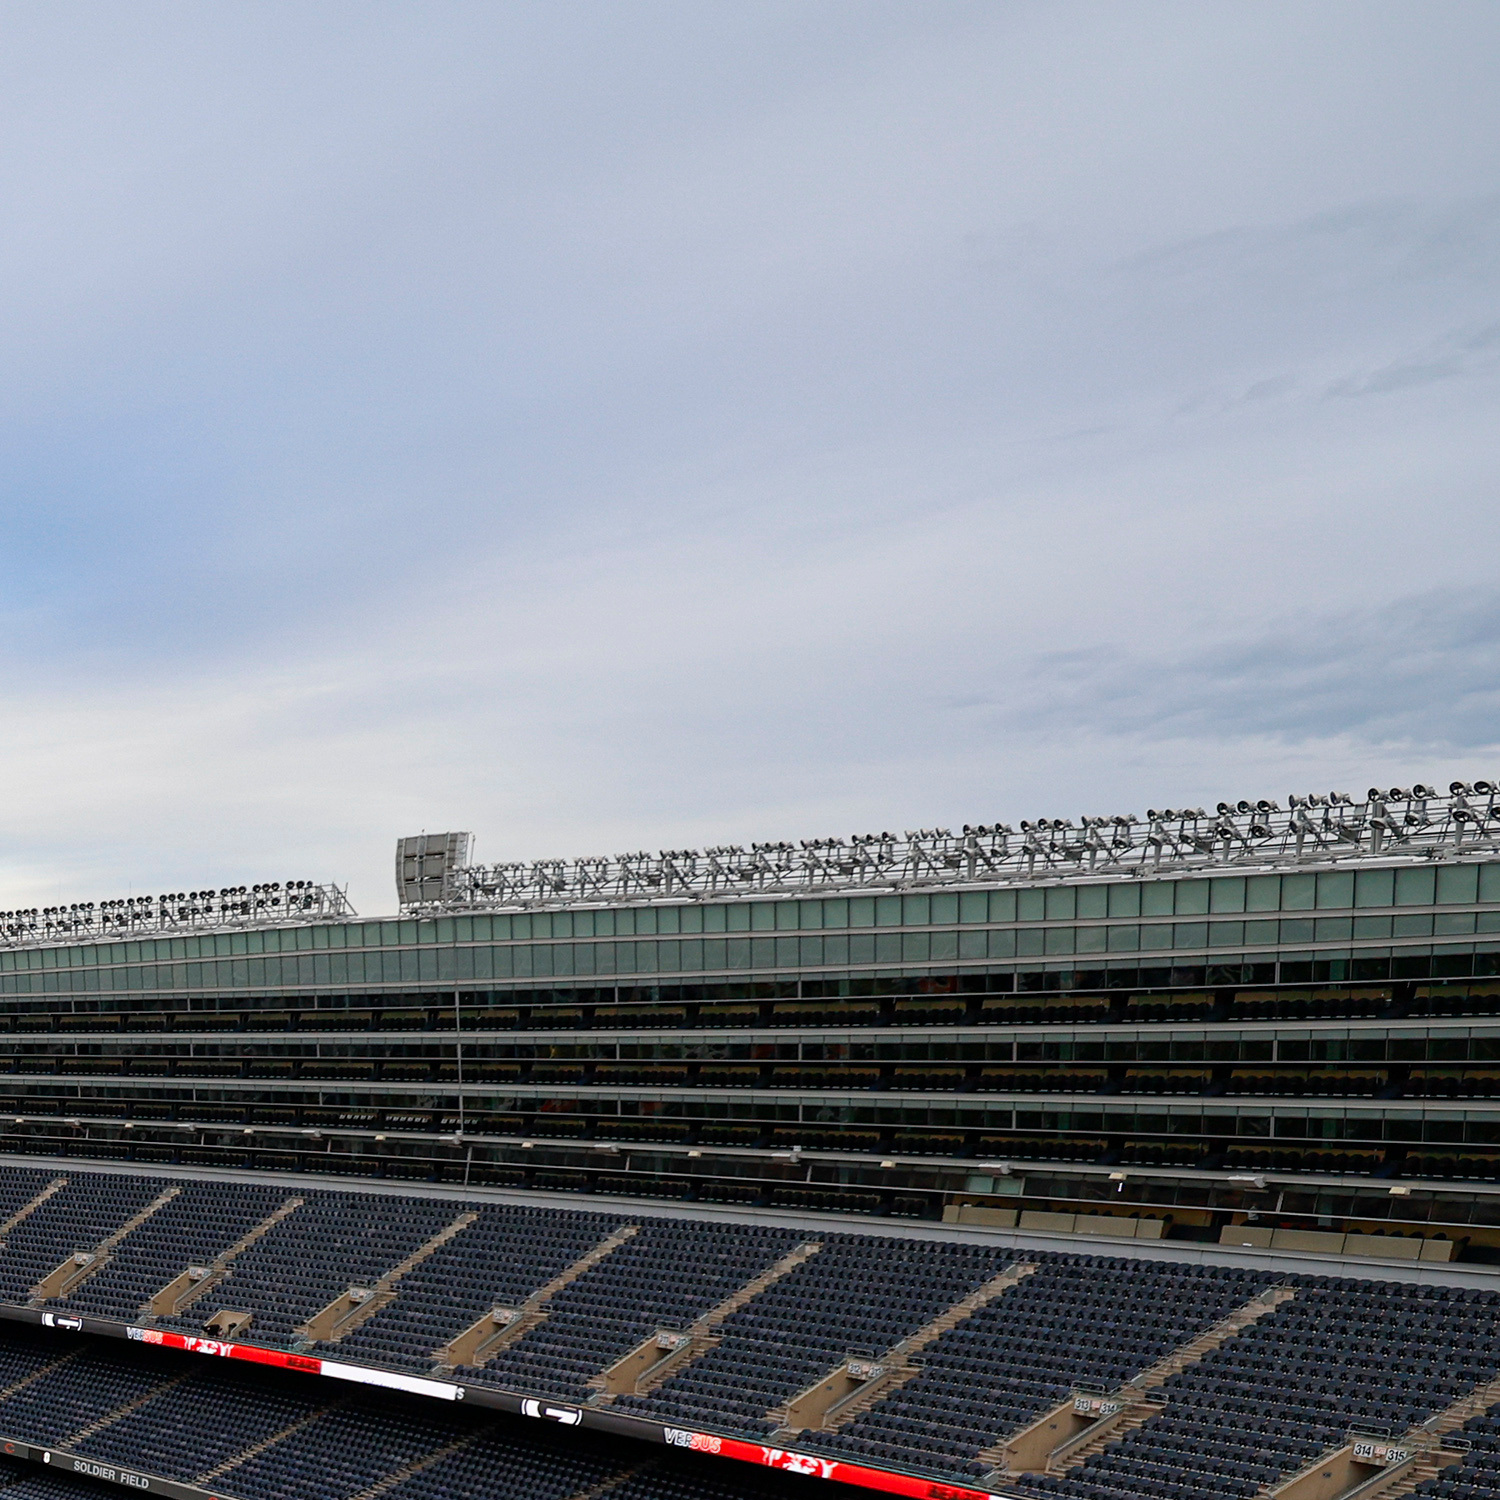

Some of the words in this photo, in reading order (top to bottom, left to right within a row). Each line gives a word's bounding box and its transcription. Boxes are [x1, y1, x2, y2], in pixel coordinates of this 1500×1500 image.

[1074, 1398, 1090, 1411] 313
[662, 1427, 722, 1454] VERSUS
[1354, 1443, 1372, 1457] 314
[1386, 1447, 1405, 1462] 315
[73, 1460, 116, 1481] SOLDIER
[120, 1472, 149, 1490] FIELD
